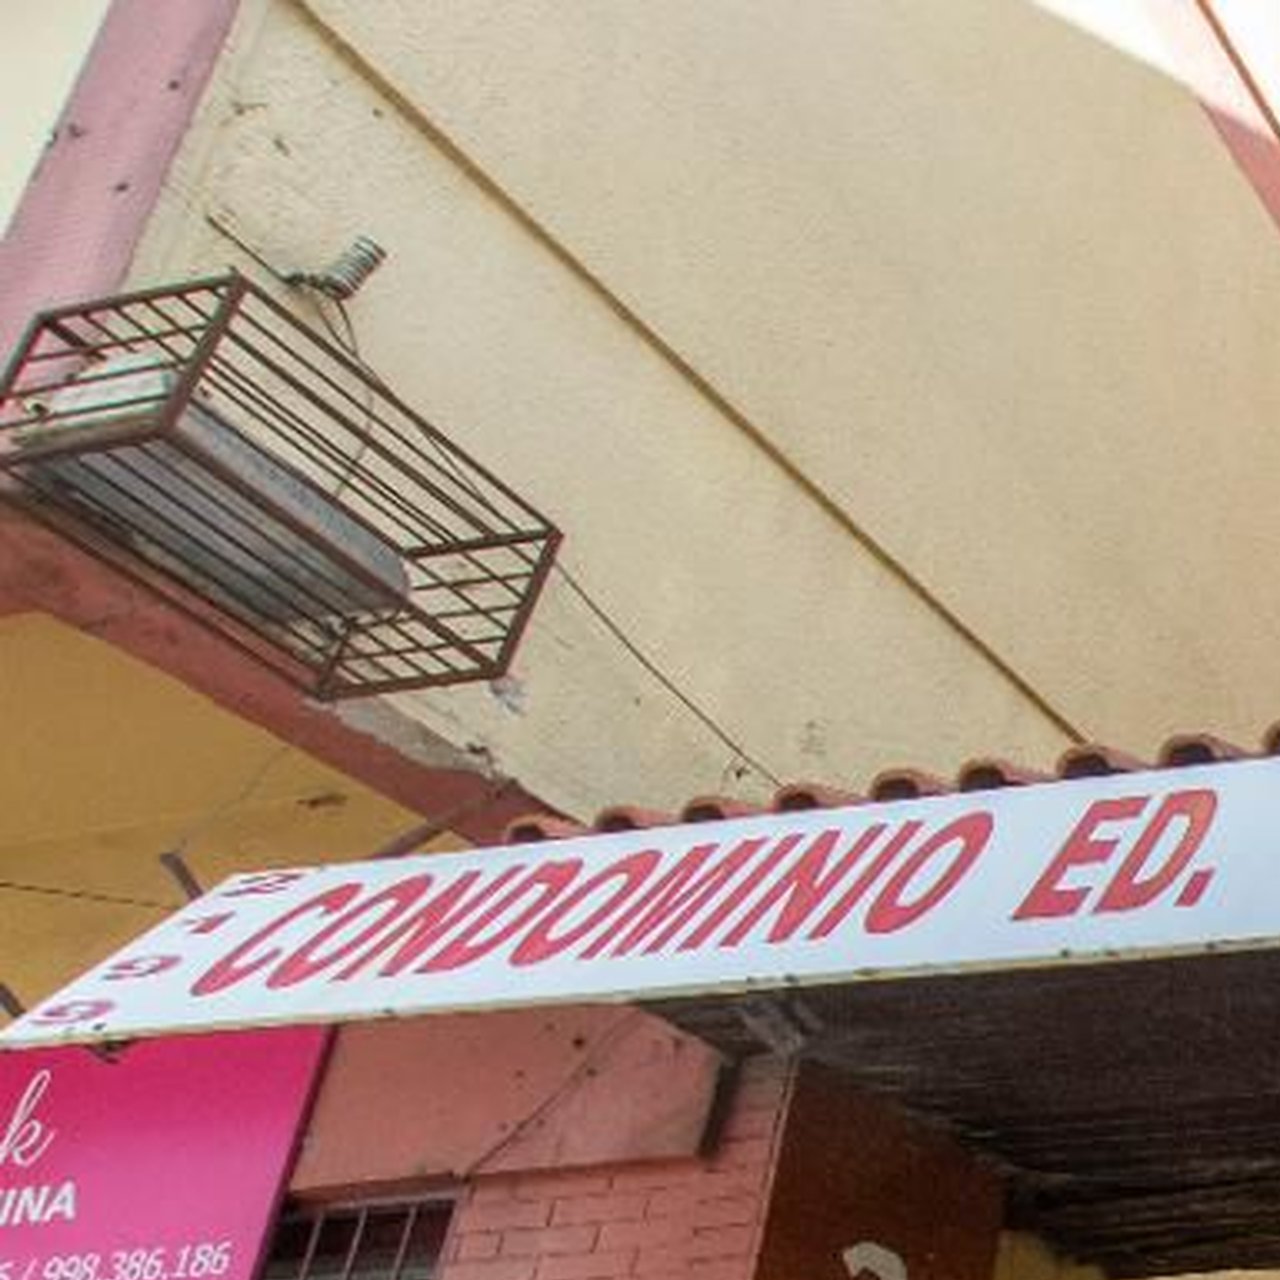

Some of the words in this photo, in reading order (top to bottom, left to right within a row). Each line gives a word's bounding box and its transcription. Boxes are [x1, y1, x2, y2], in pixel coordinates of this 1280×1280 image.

[191, 810, 994, 997] CONDOMINIO
[1010, 788, 1218, 920] ED.
[0, 1179, 77, 1226] INA
